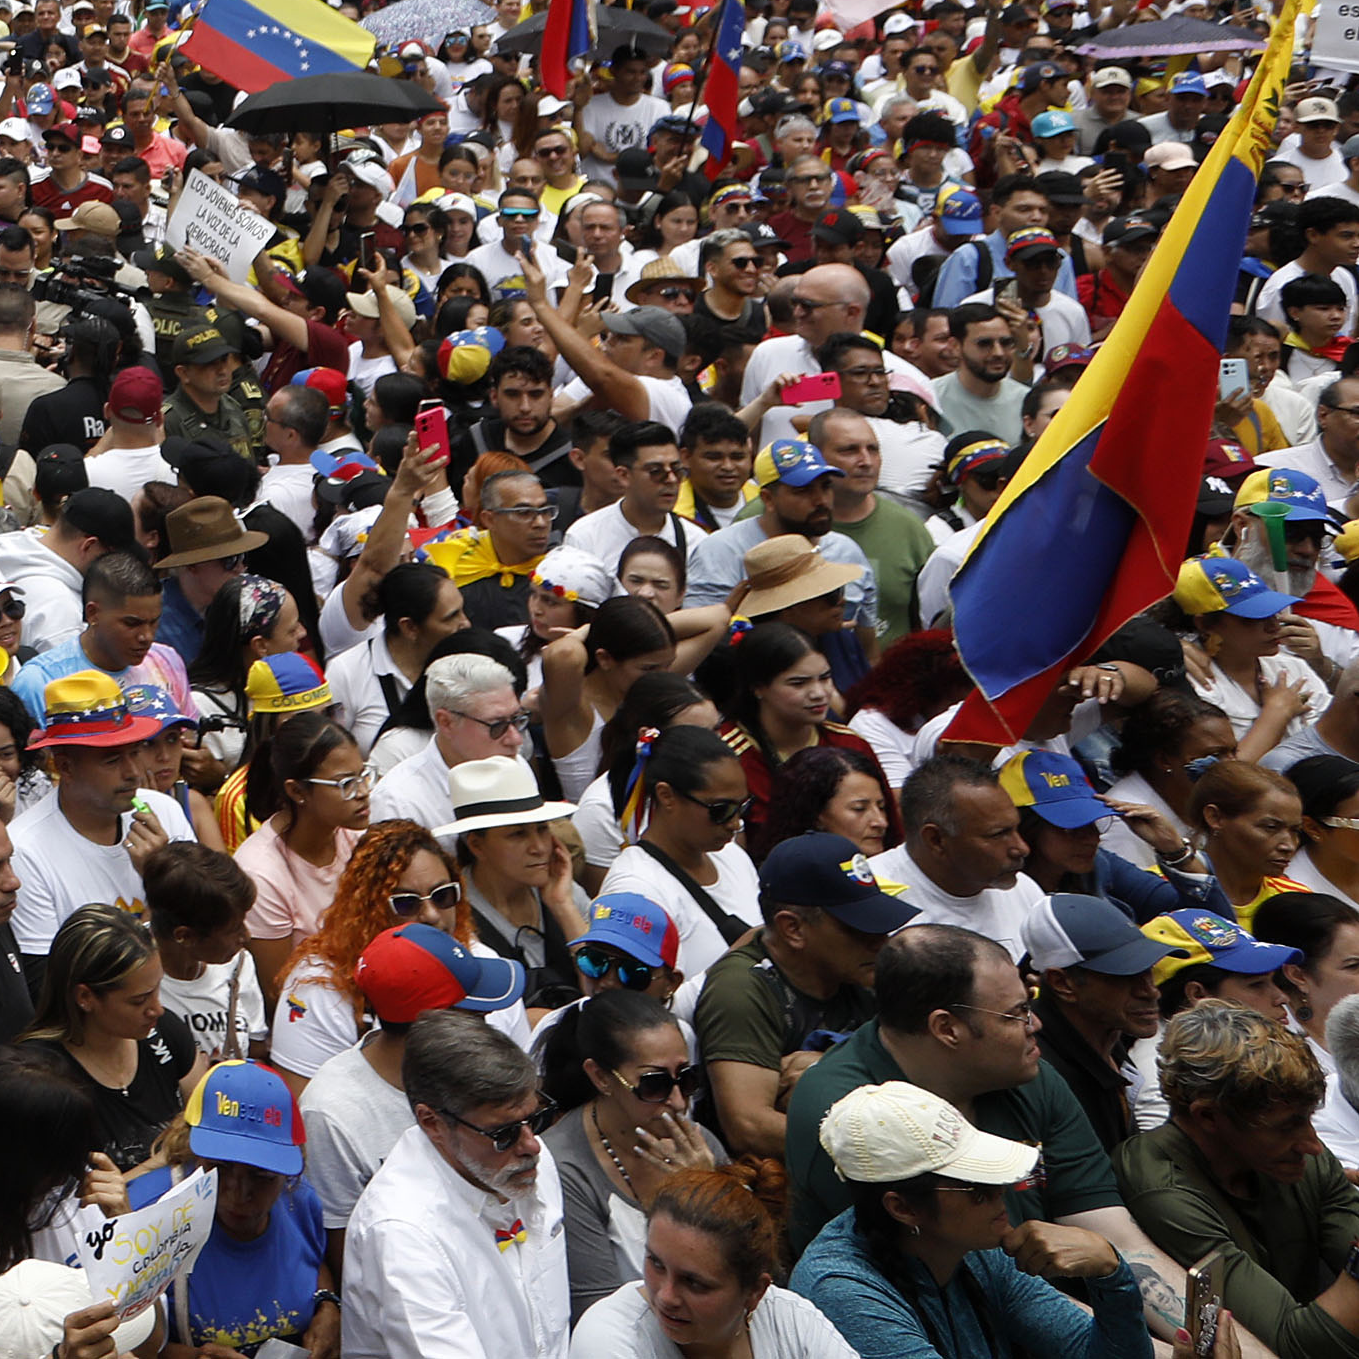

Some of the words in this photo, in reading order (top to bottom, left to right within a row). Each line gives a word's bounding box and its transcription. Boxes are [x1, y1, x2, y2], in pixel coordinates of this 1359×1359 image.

[190, 176, 208, 195] LOS
[205, 188, 238, 220] JÓVENES
[236, 212, 268, 240] SOMOS
[196, 204, 206, 221] LA
[206, 211, 221, 232] VOZ
[219, 222, 231, 239] DE
[228, 232, 241, 247] LA
[188, 221, 232, 265] DEMOCRACIA
[594, 903, 653, 935] Venezuela
[214, 1091, 281, 1128] Venezuela
[86, 1219, 119, 1261] yo
[112, 1217, 164, 1266] SOY
[171, 1197, 197, 1233] DE
[132, 1222, 193, 1274] COLOMBIA
